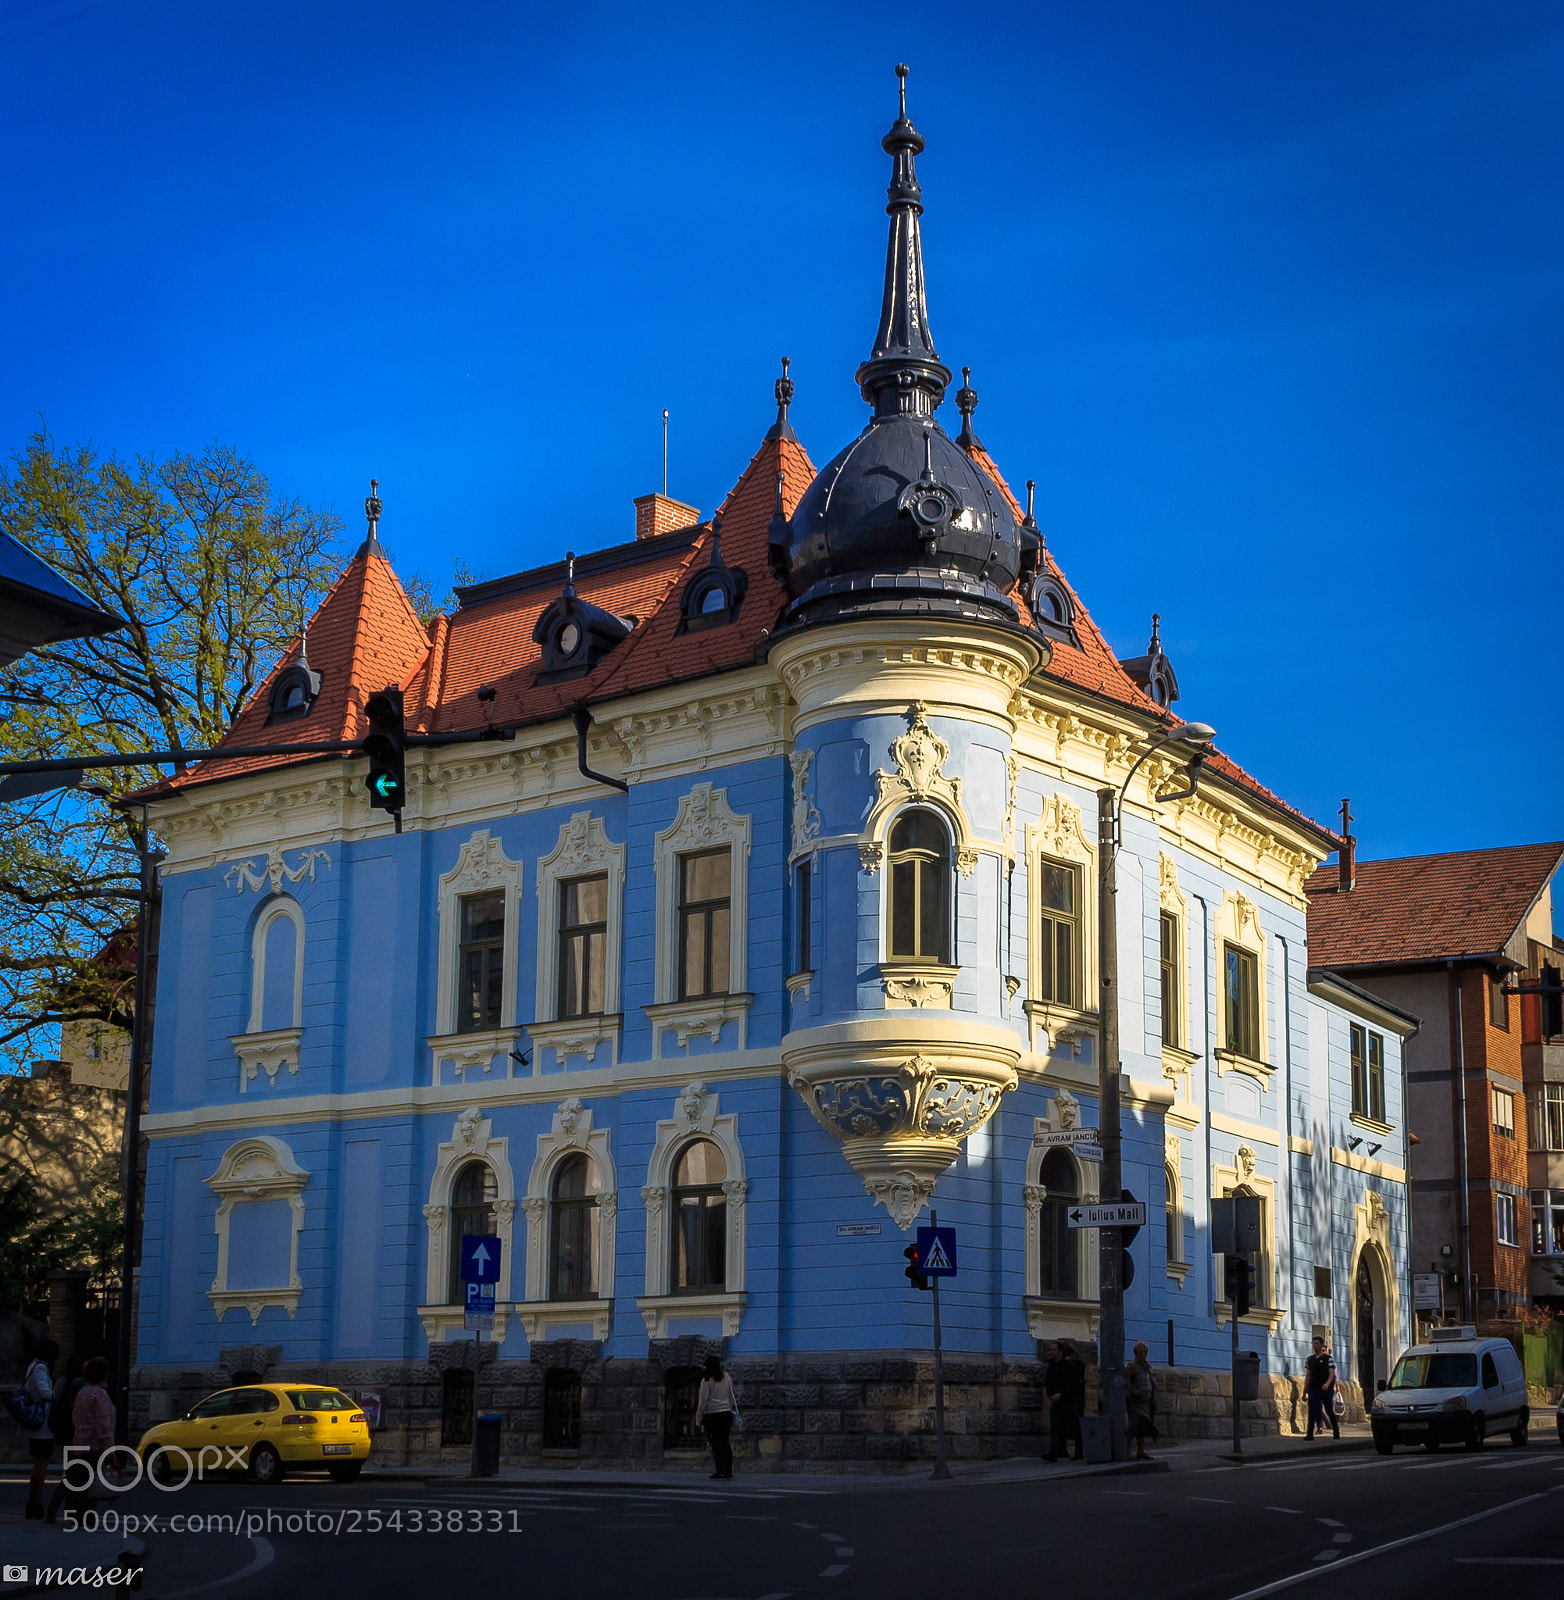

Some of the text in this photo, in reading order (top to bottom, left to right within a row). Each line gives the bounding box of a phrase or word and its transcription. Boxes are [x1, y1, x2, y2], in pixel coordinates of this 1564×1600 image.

[1047, 1134, 1072, 1143] AVRAM
[1073, 1132, 1096, 1142] IANCU
[1088, 1207, 1140, 1222] Iulius Mall
[467, 1283, 479, 1304] P
